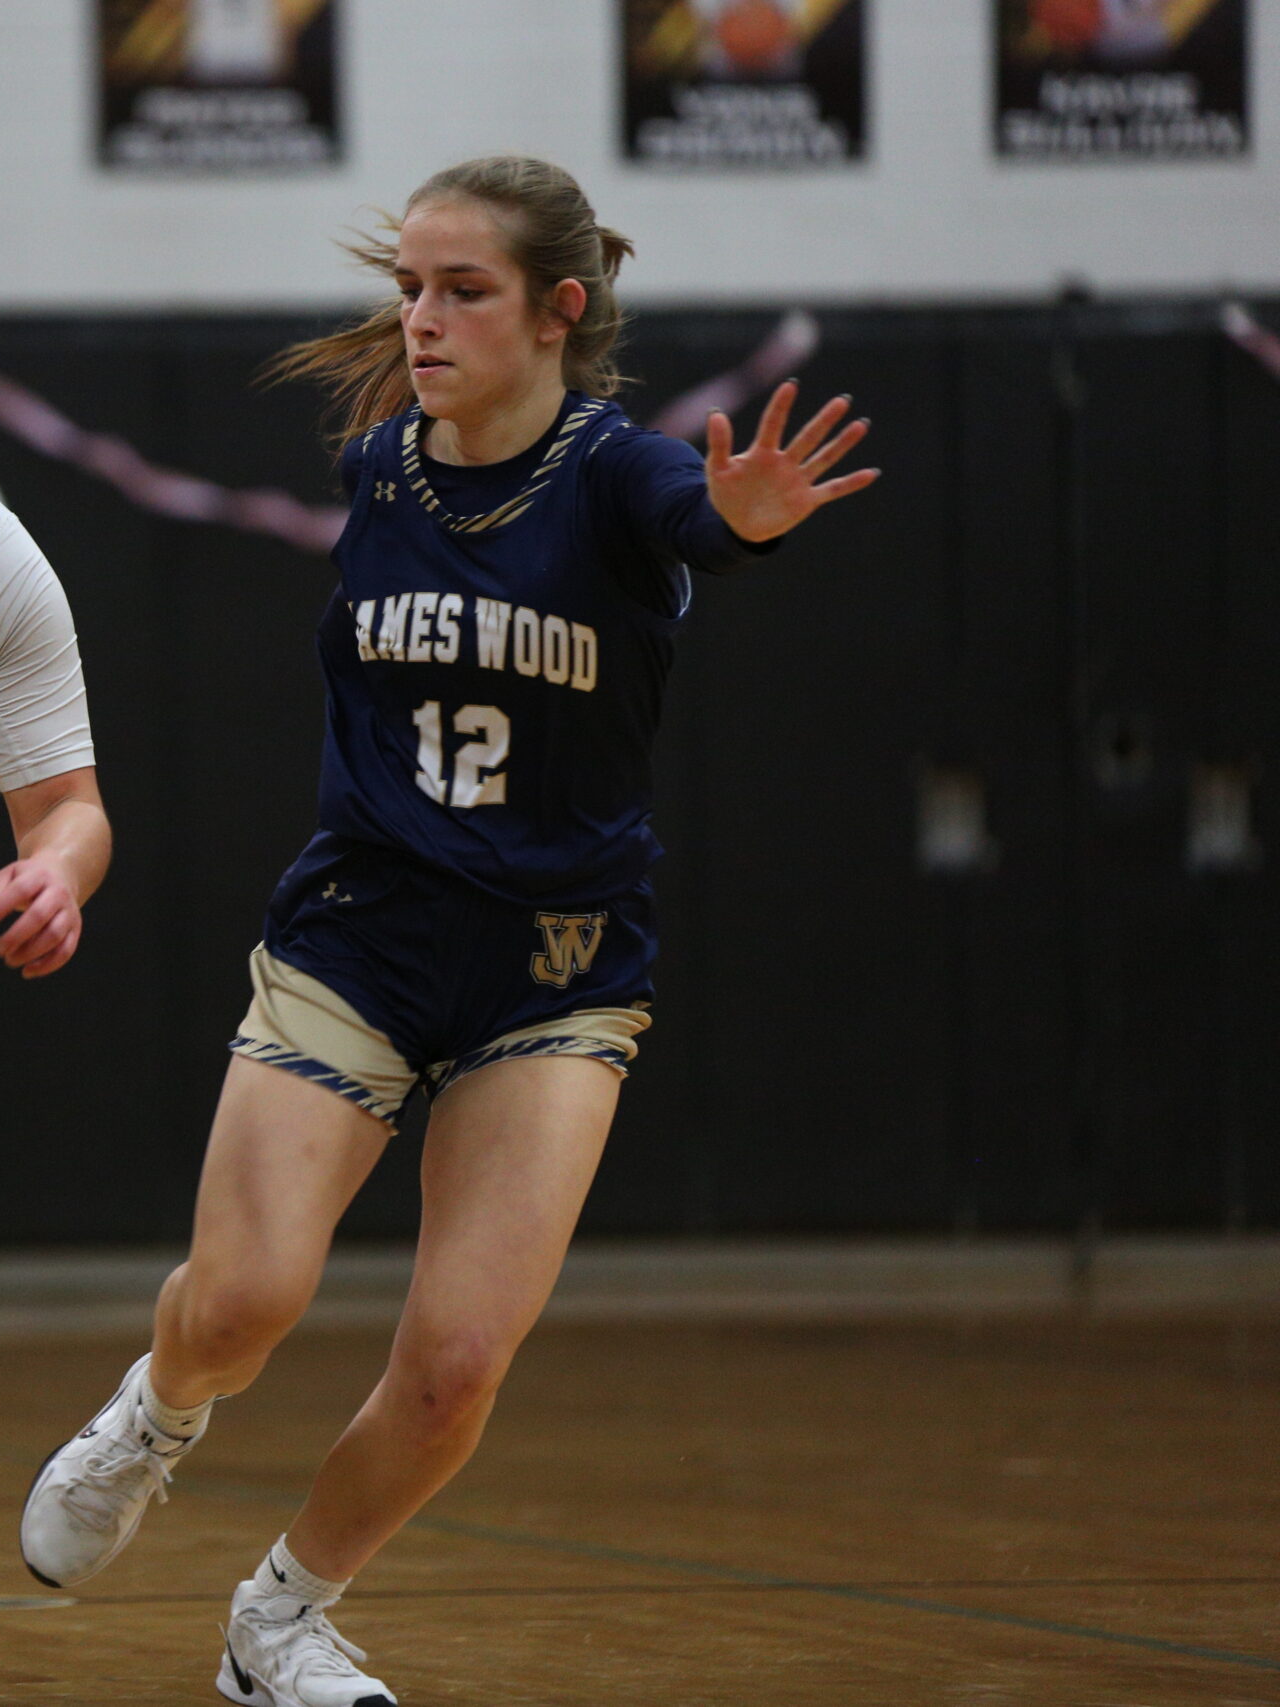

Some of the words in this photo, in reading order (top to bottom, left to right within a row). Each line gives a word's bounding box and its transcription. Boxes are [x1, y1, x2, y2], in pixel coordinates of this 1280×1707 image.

[348, 592, 463, 664] AMES
[476, 597, 598, 692] WOOD
[412, 700, 511, 808] 12
